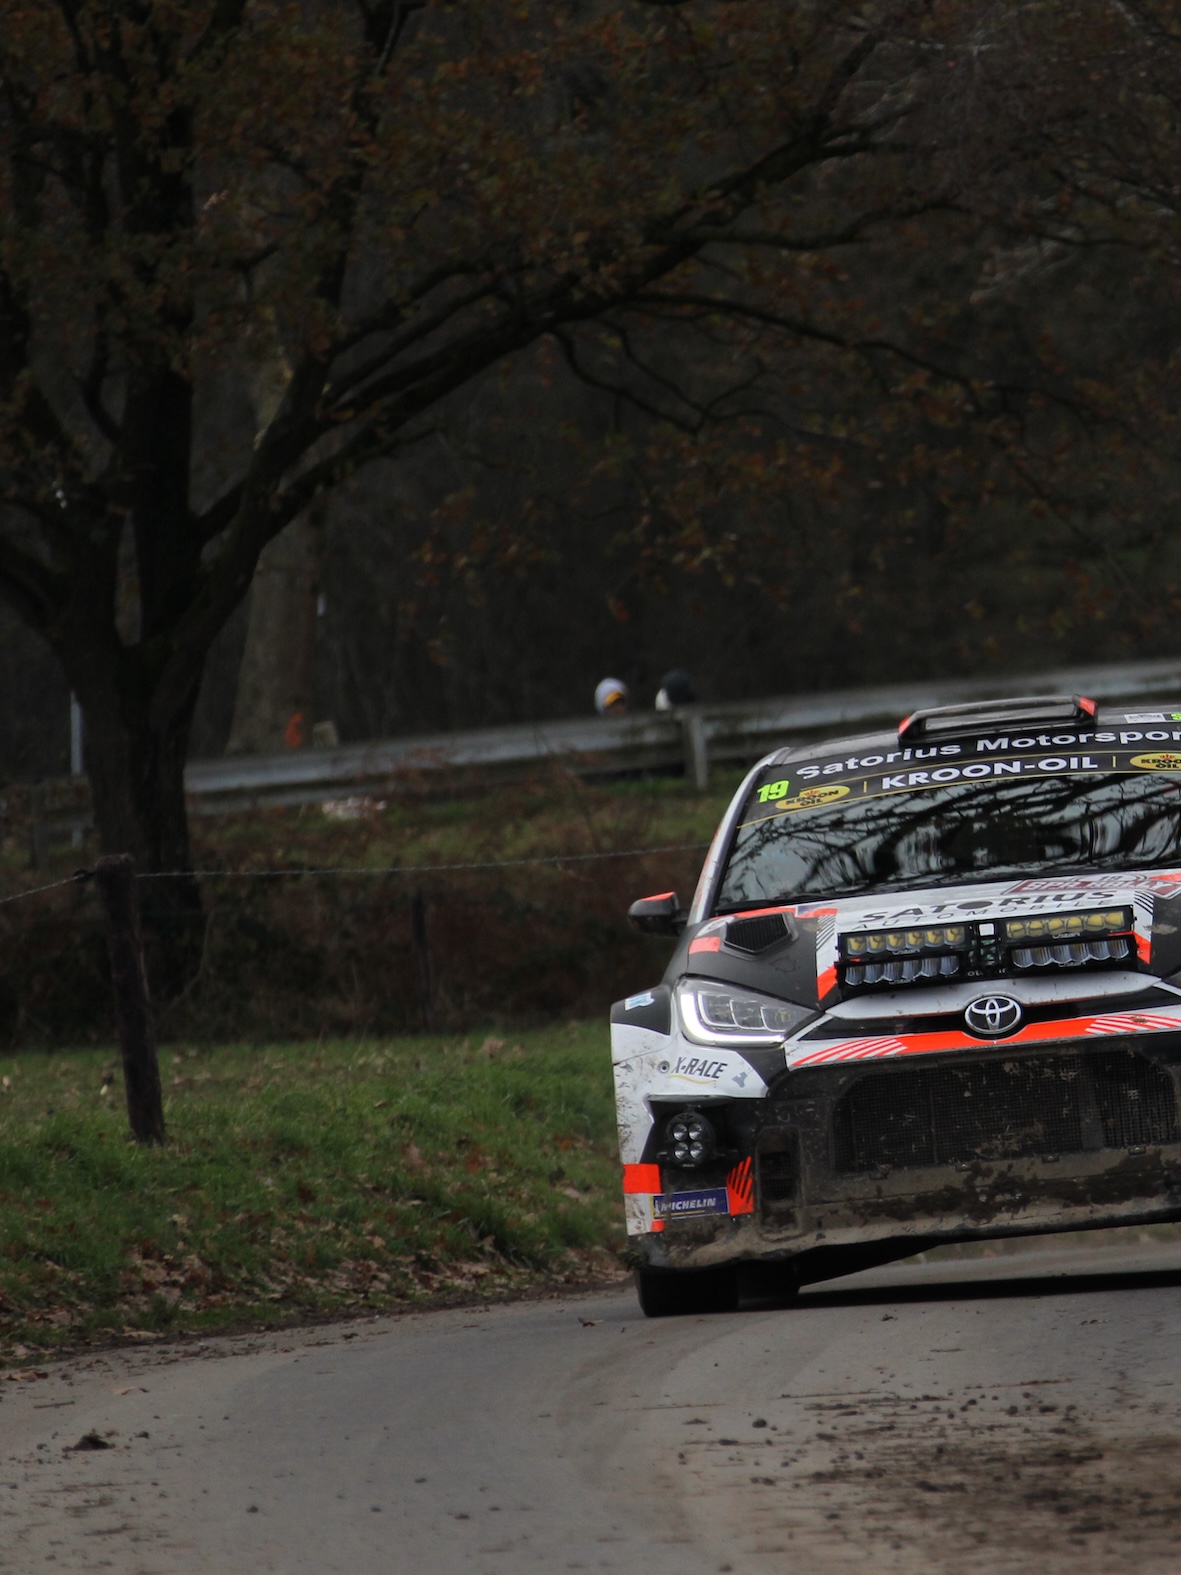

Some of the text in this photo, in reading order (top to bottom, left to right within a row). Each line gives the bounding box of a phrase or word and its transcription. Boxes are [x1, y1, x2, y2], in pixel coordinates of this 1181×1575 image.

[797, 744, 961, 779] Satorius
[882, 756, 1099, 789] KROON-OIL
[757, 780, 790, 803] 19
[786, 790, 839, 805] KROON
[671, 1056, 729, 1079] X-RACE
[661, 1198, 717, 1212] MICHELIN
